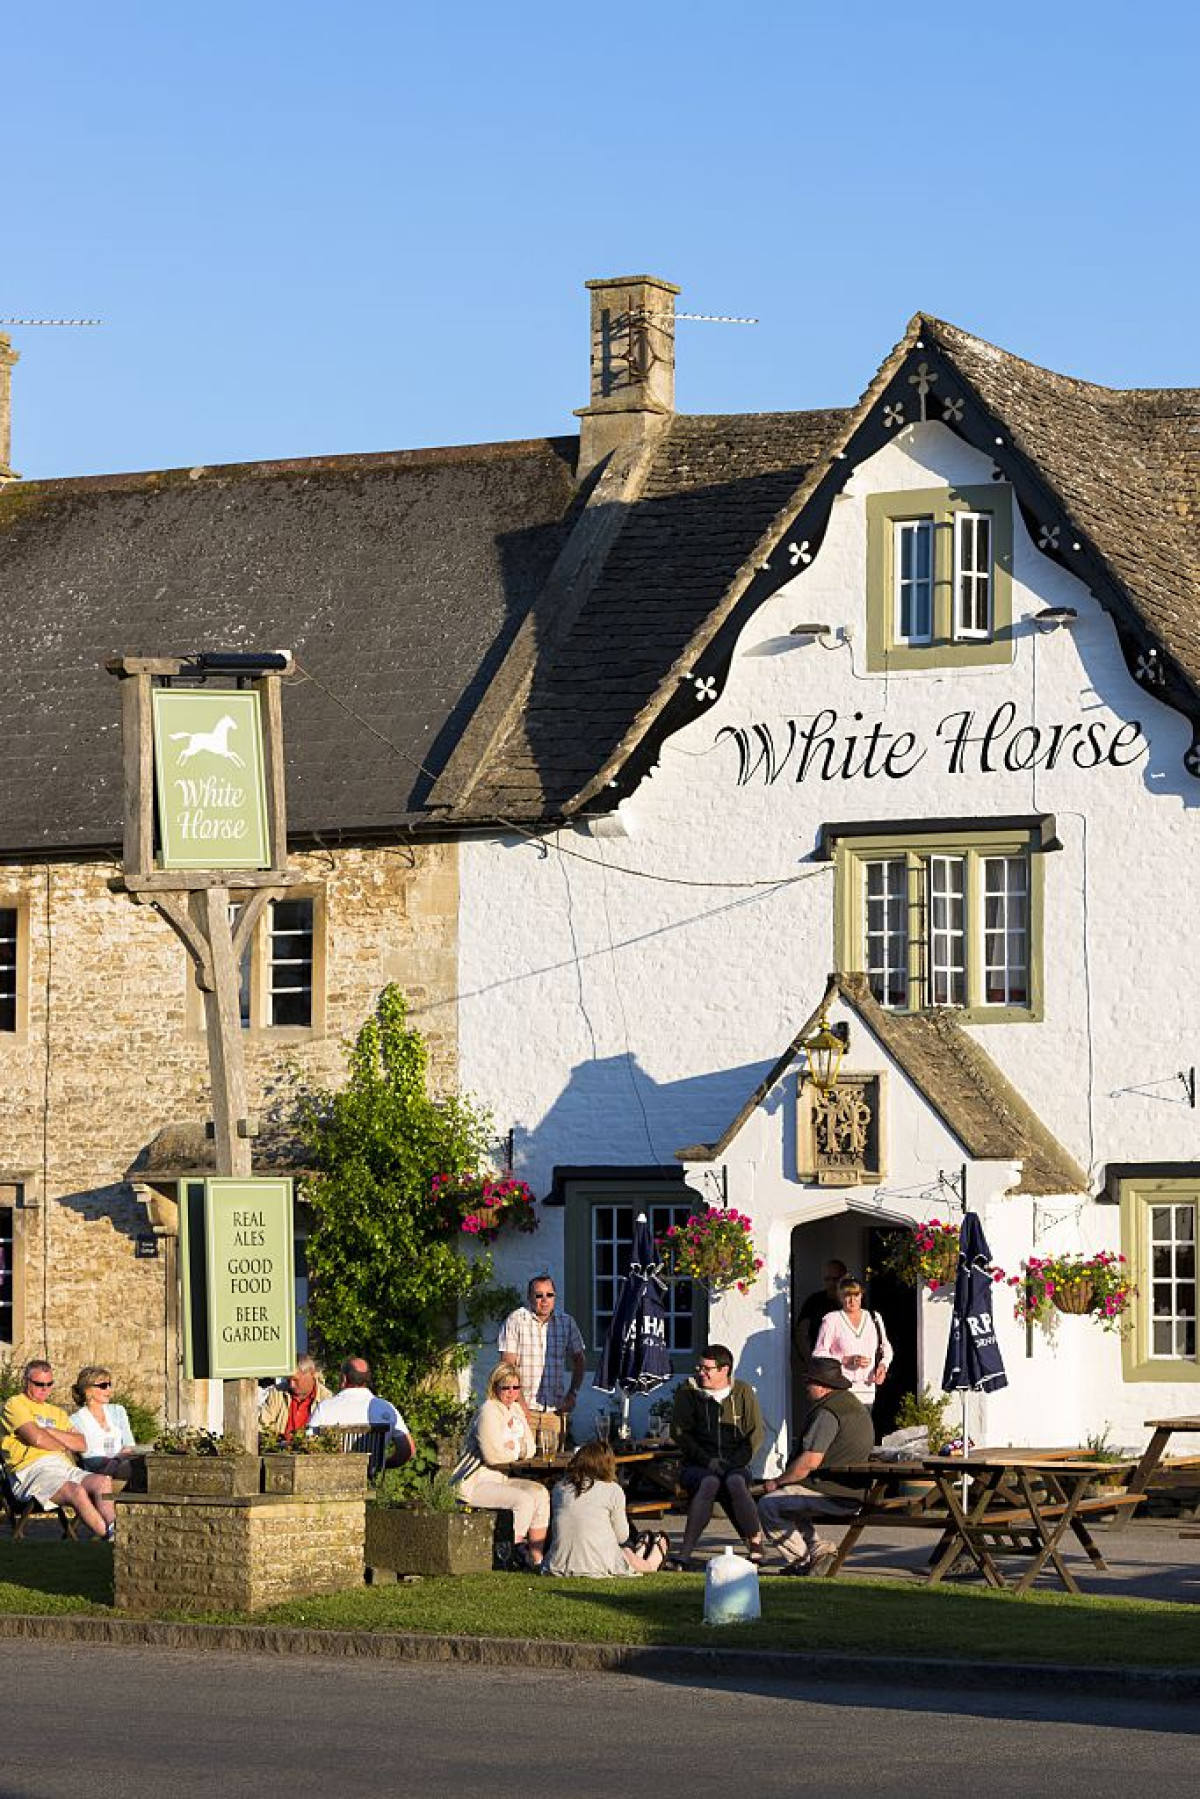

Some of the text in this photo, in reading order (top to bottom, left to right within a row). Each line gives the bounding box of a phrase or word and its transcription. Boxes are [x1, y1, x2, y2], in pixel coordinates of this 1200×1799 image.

[714, 701, 1151, 785] White Horse
[173, 775, 247, 807] White
[176, 807, 248, 839] Horse
[233, 1211, 266, 1227] REAL
[233, 1230, 266, 1246] ALES
[227, 1258, 273, 1275] GOOD
[231, 1278, 272, 1294] FOOD
[236, 1306, 269, 1322] BEER
[222, 1325, 281, 1342] GARDEN
